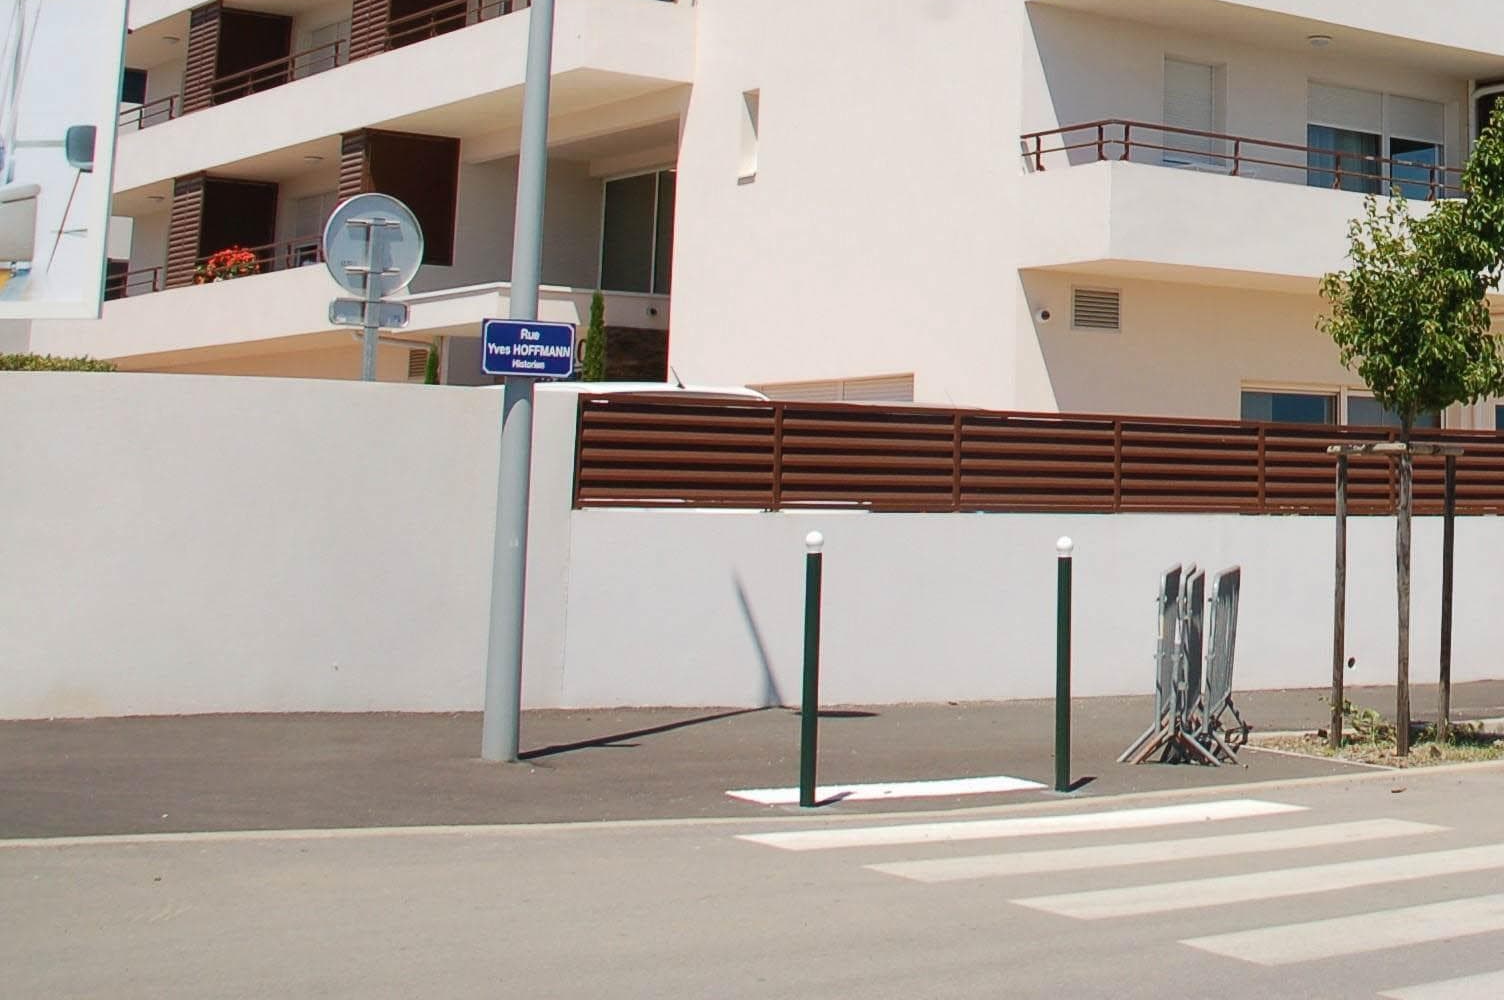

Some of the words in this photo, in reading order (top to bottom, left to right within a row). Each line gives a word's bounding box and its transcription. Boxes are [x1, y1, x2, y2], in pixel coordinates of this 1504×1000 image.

[520, 328, 540, 340] Rue
[487, 342, 511, 355] Yves
[513, 343, 571, 358] HOFFMANN
